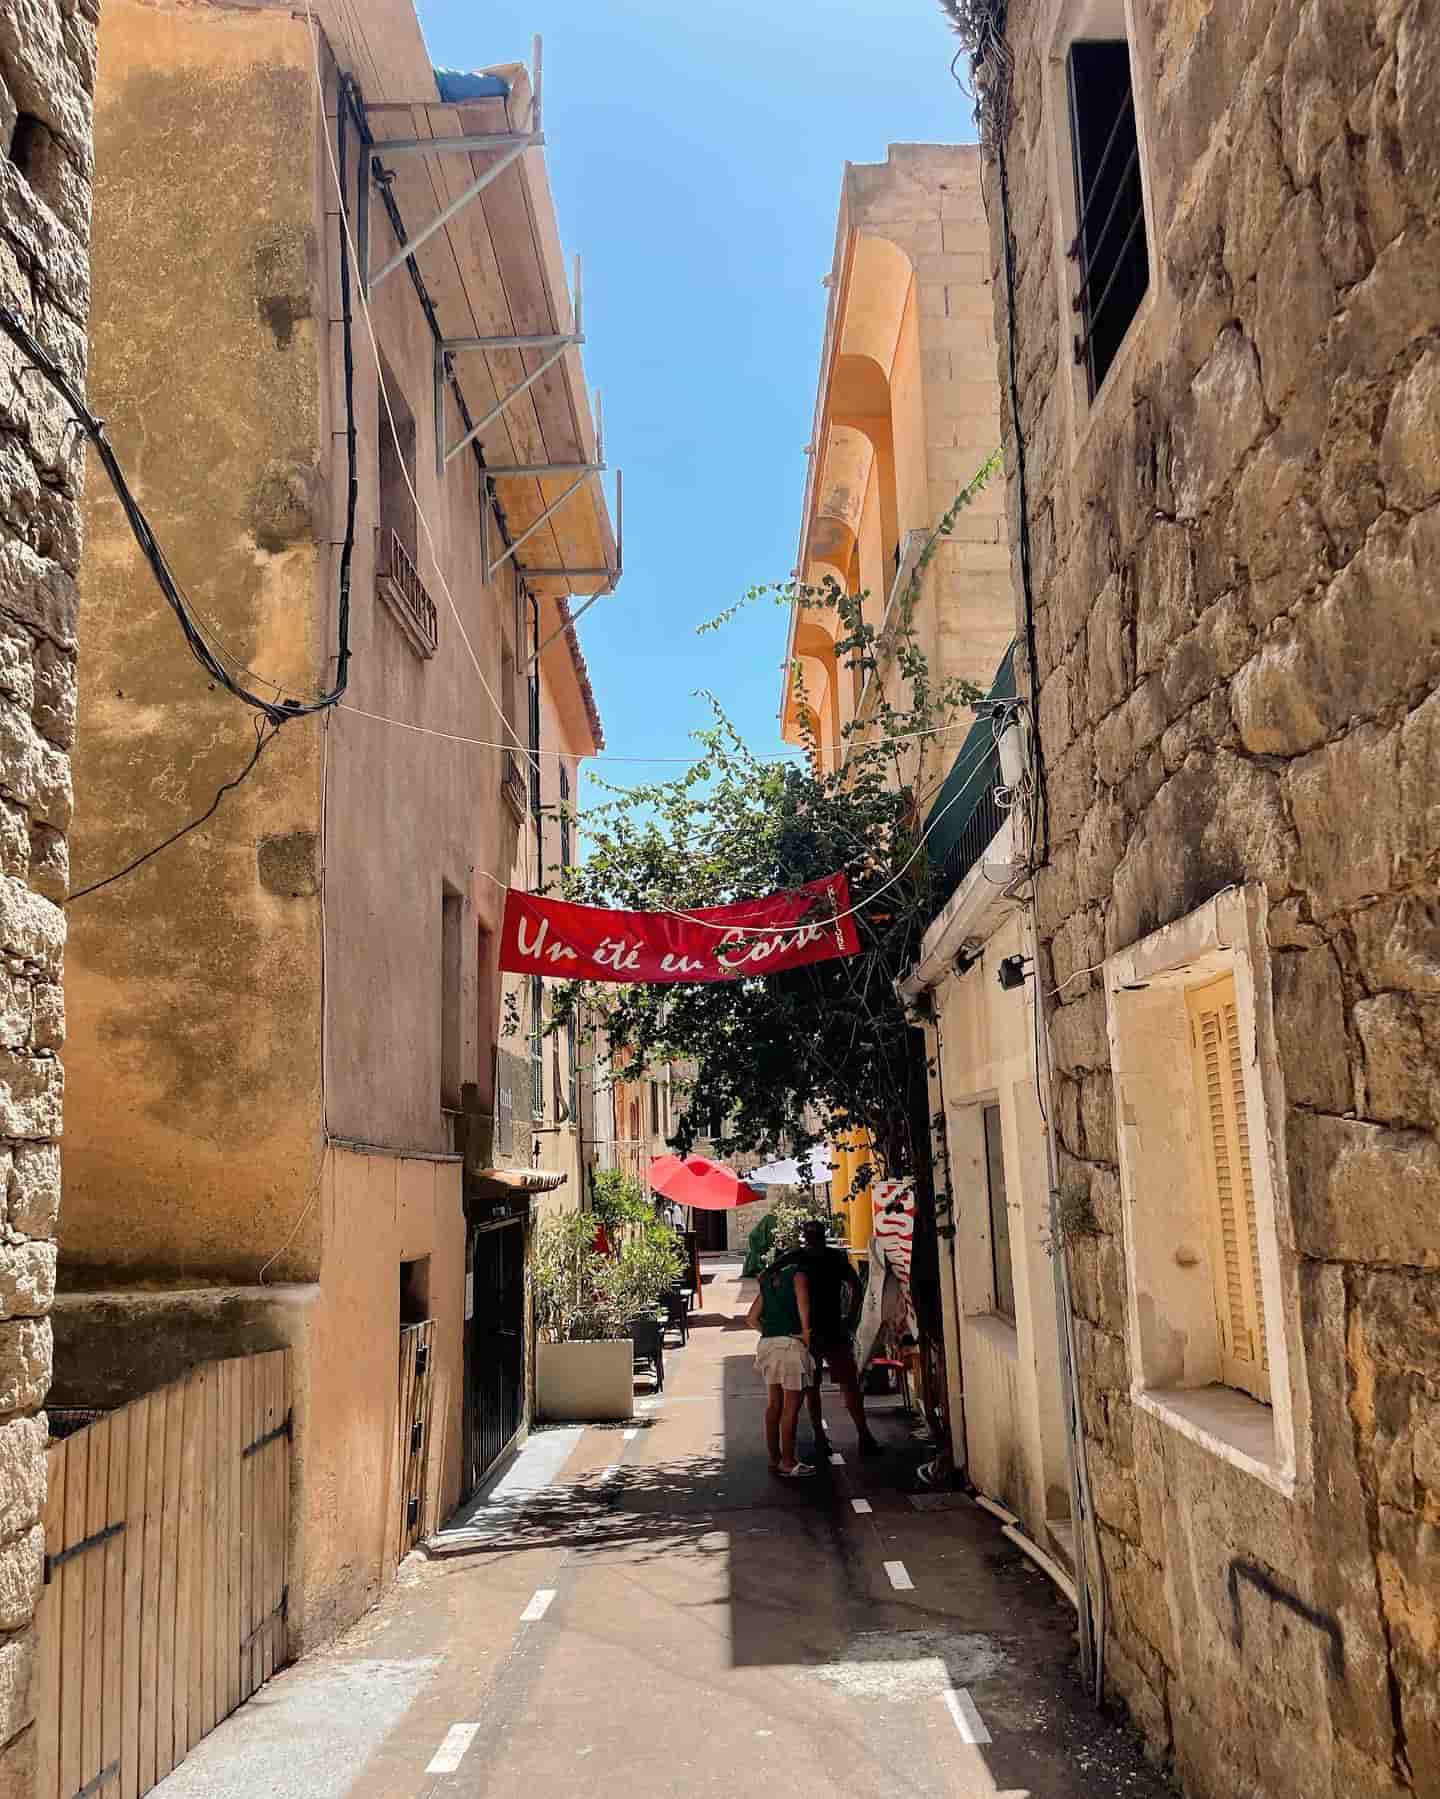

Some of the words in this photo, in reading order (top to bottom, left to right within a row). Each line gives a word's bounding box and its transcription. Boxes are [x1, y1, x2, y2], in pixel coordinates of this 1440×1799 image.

[517, 915, 578, 962] Un
[592, 936, 644, 970] été
[660, 952, 704, 973] en
